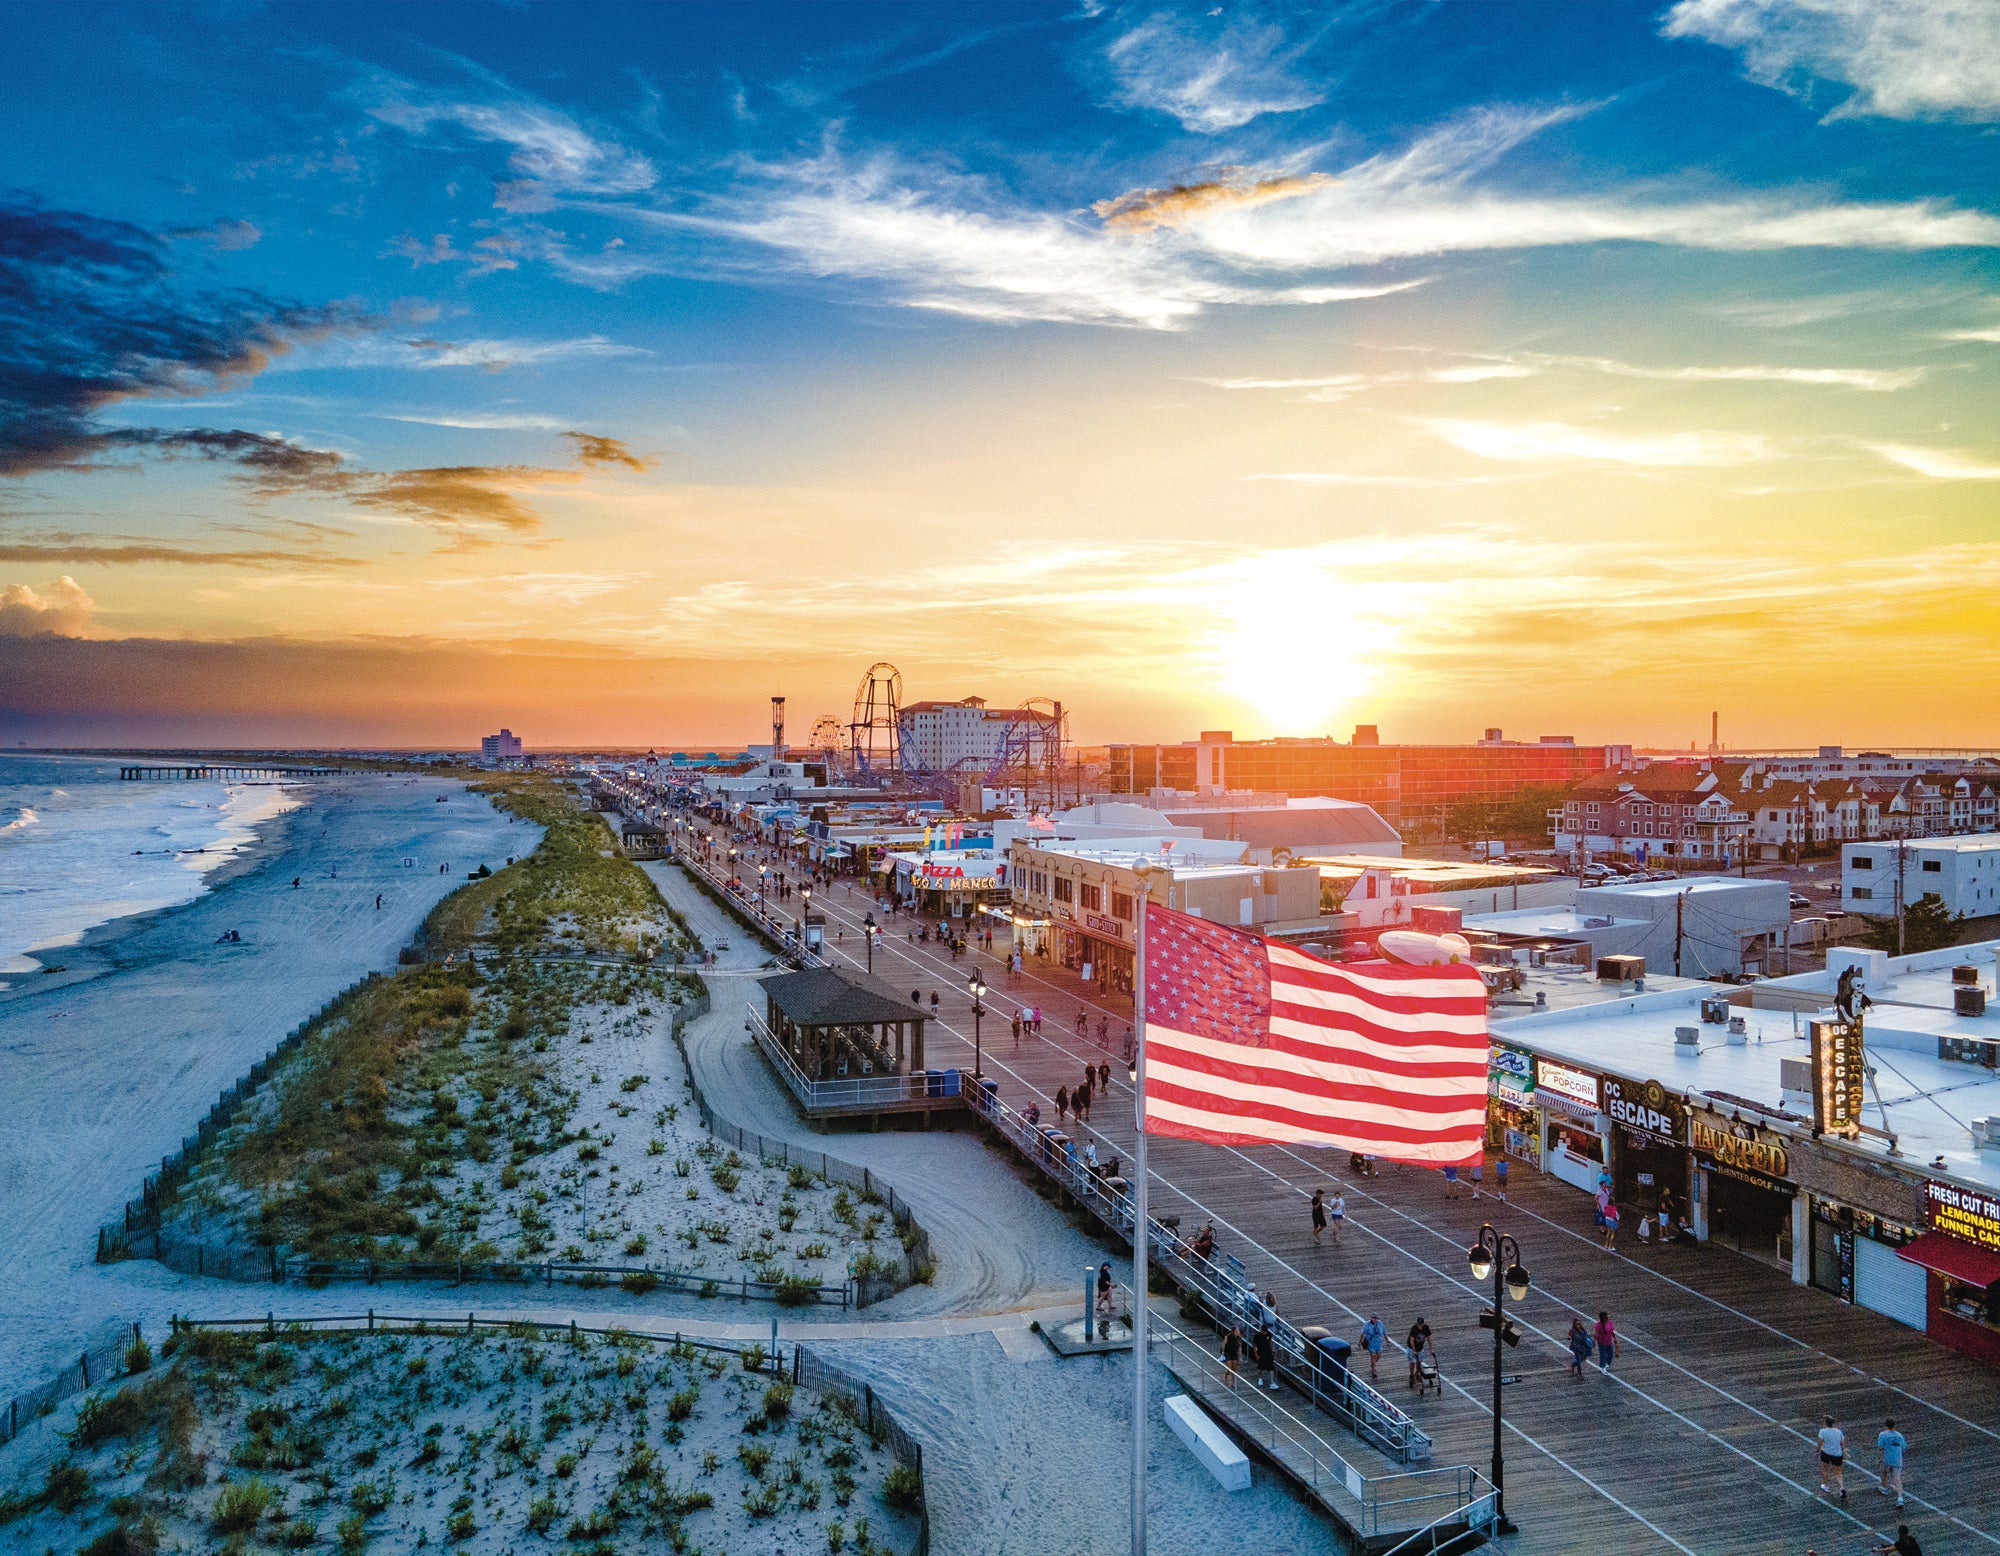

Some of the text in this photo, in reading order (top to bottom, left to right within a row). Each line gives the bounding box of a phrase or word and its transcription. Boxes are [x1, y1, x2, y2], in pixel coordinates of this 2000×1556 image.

[922, 865, 964, 877] PIZZA
[1553, 1076, 1594, 1096] POPCORN
[1832, 1025, 1848, 1119] OC ESCAPE
[1605, 1081, 1620, 1098] OC
[1610, 1100, 1672, 1135] ESCAPE
[1693, 1120, 1787, 1177] HAUNTED
[1750, 1176, 1773, 1191] GOLF
[1928, 1184, 2000, 1220] FRESH CUT FRI
[1935, 1215, 2000, 1247] FUNNEL CAK
[1941, 1204, 2000, 1233] LEMONADE
